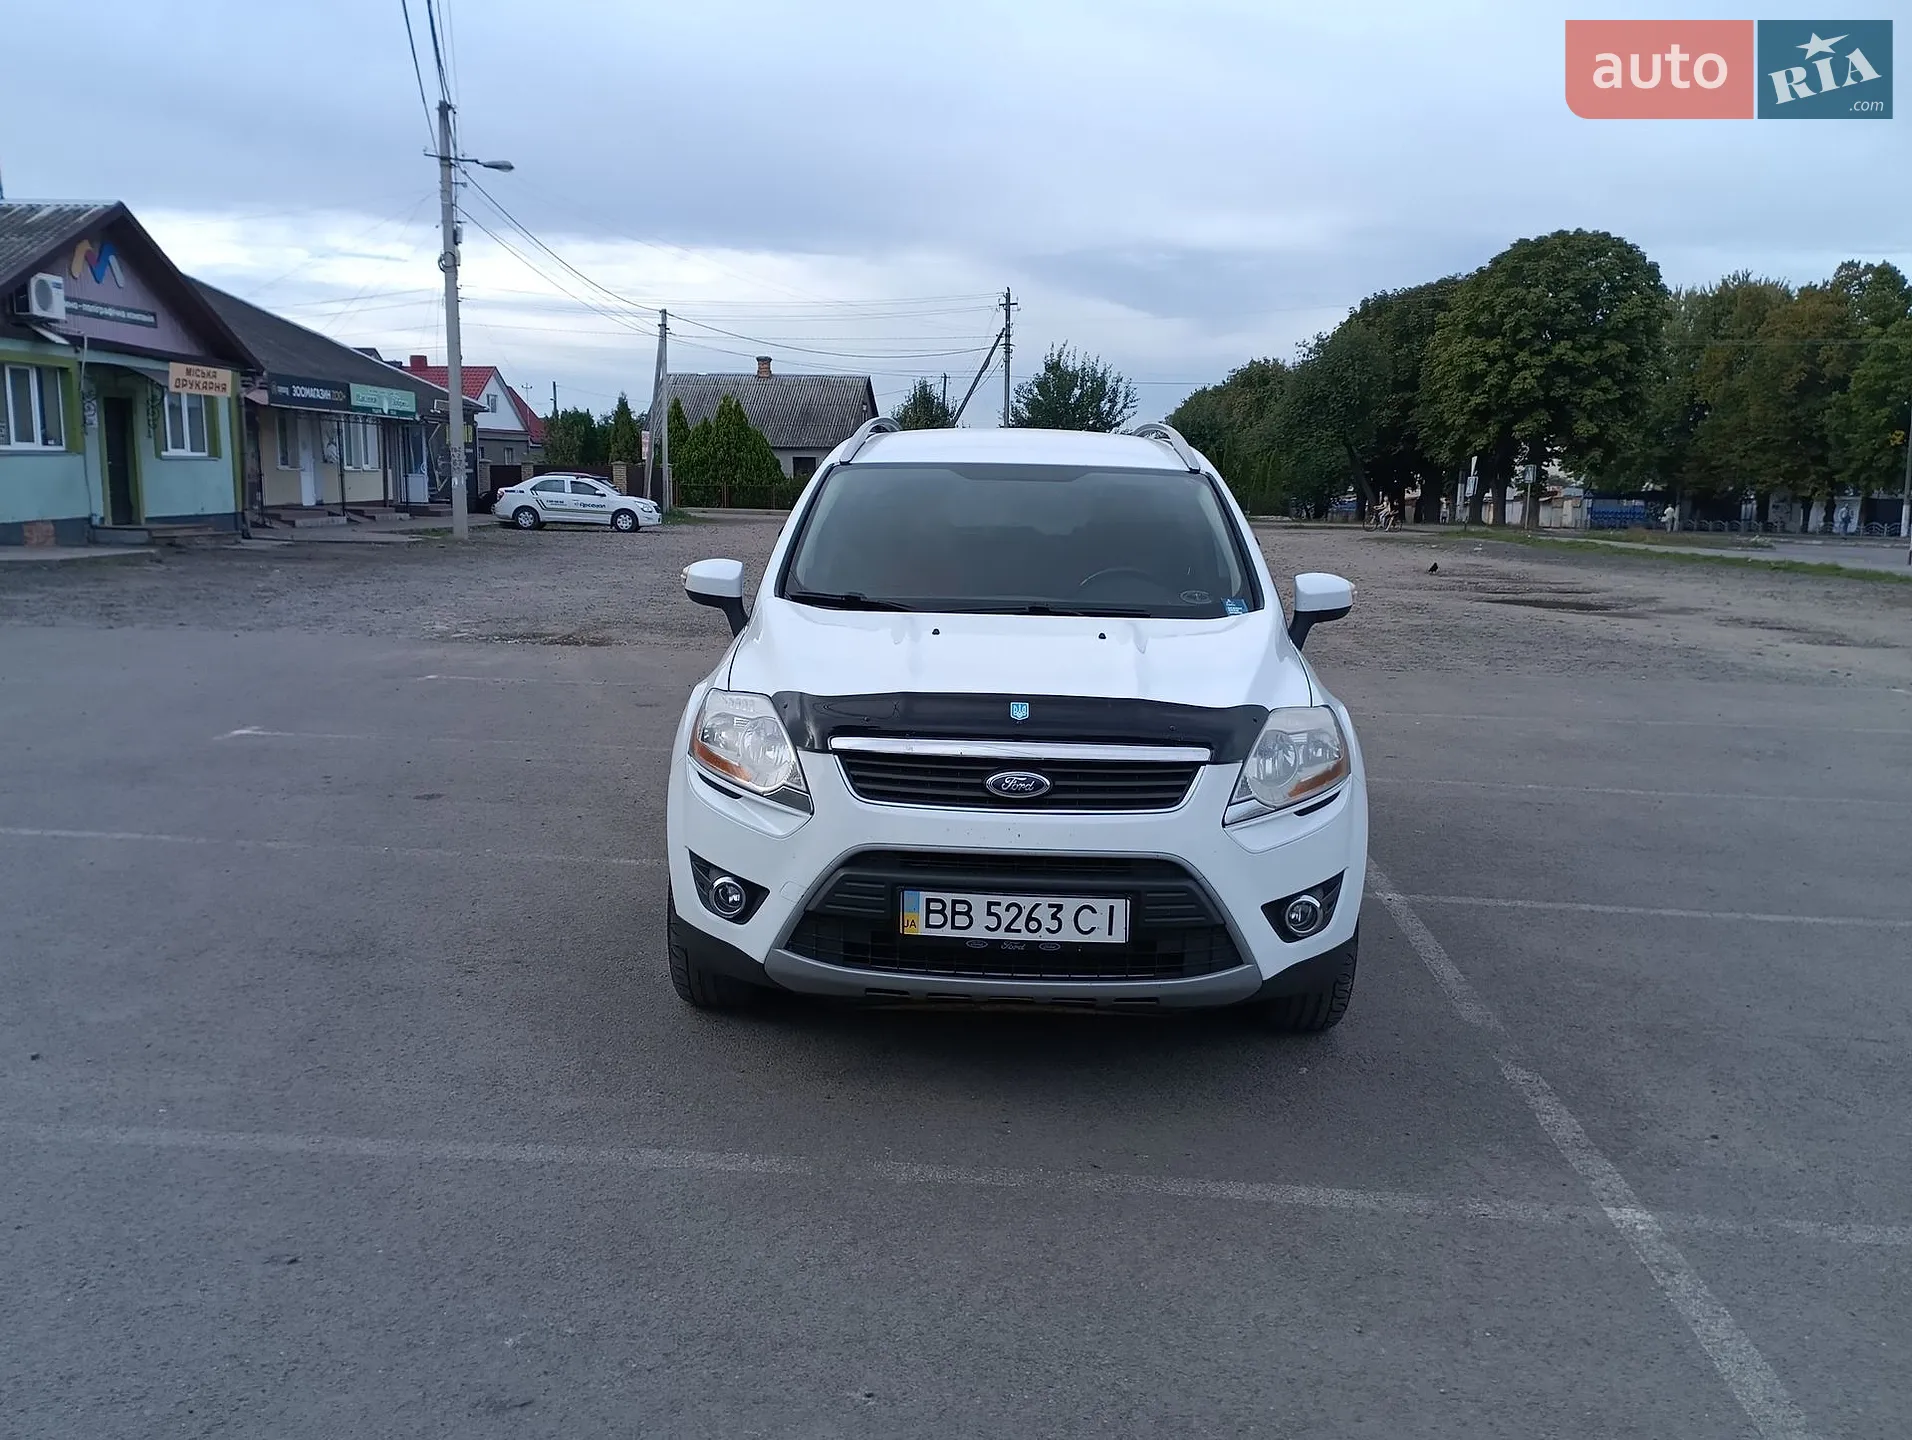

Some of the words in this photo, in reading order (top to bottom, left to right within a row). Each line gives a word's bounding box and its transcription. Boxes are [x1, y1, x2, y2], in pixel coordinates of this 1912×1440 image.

[185, 366, 217, 379] МІСЬКА
[174, 378, 227, 392] ДРУКАРНЯ
[291, 384, 331, 400] ЗООМАГАЗИН
[1001, 776, 1035, 791] Ford
[924, 897, 974, 931] BB
[984, 901, 1064, 935] 5263
